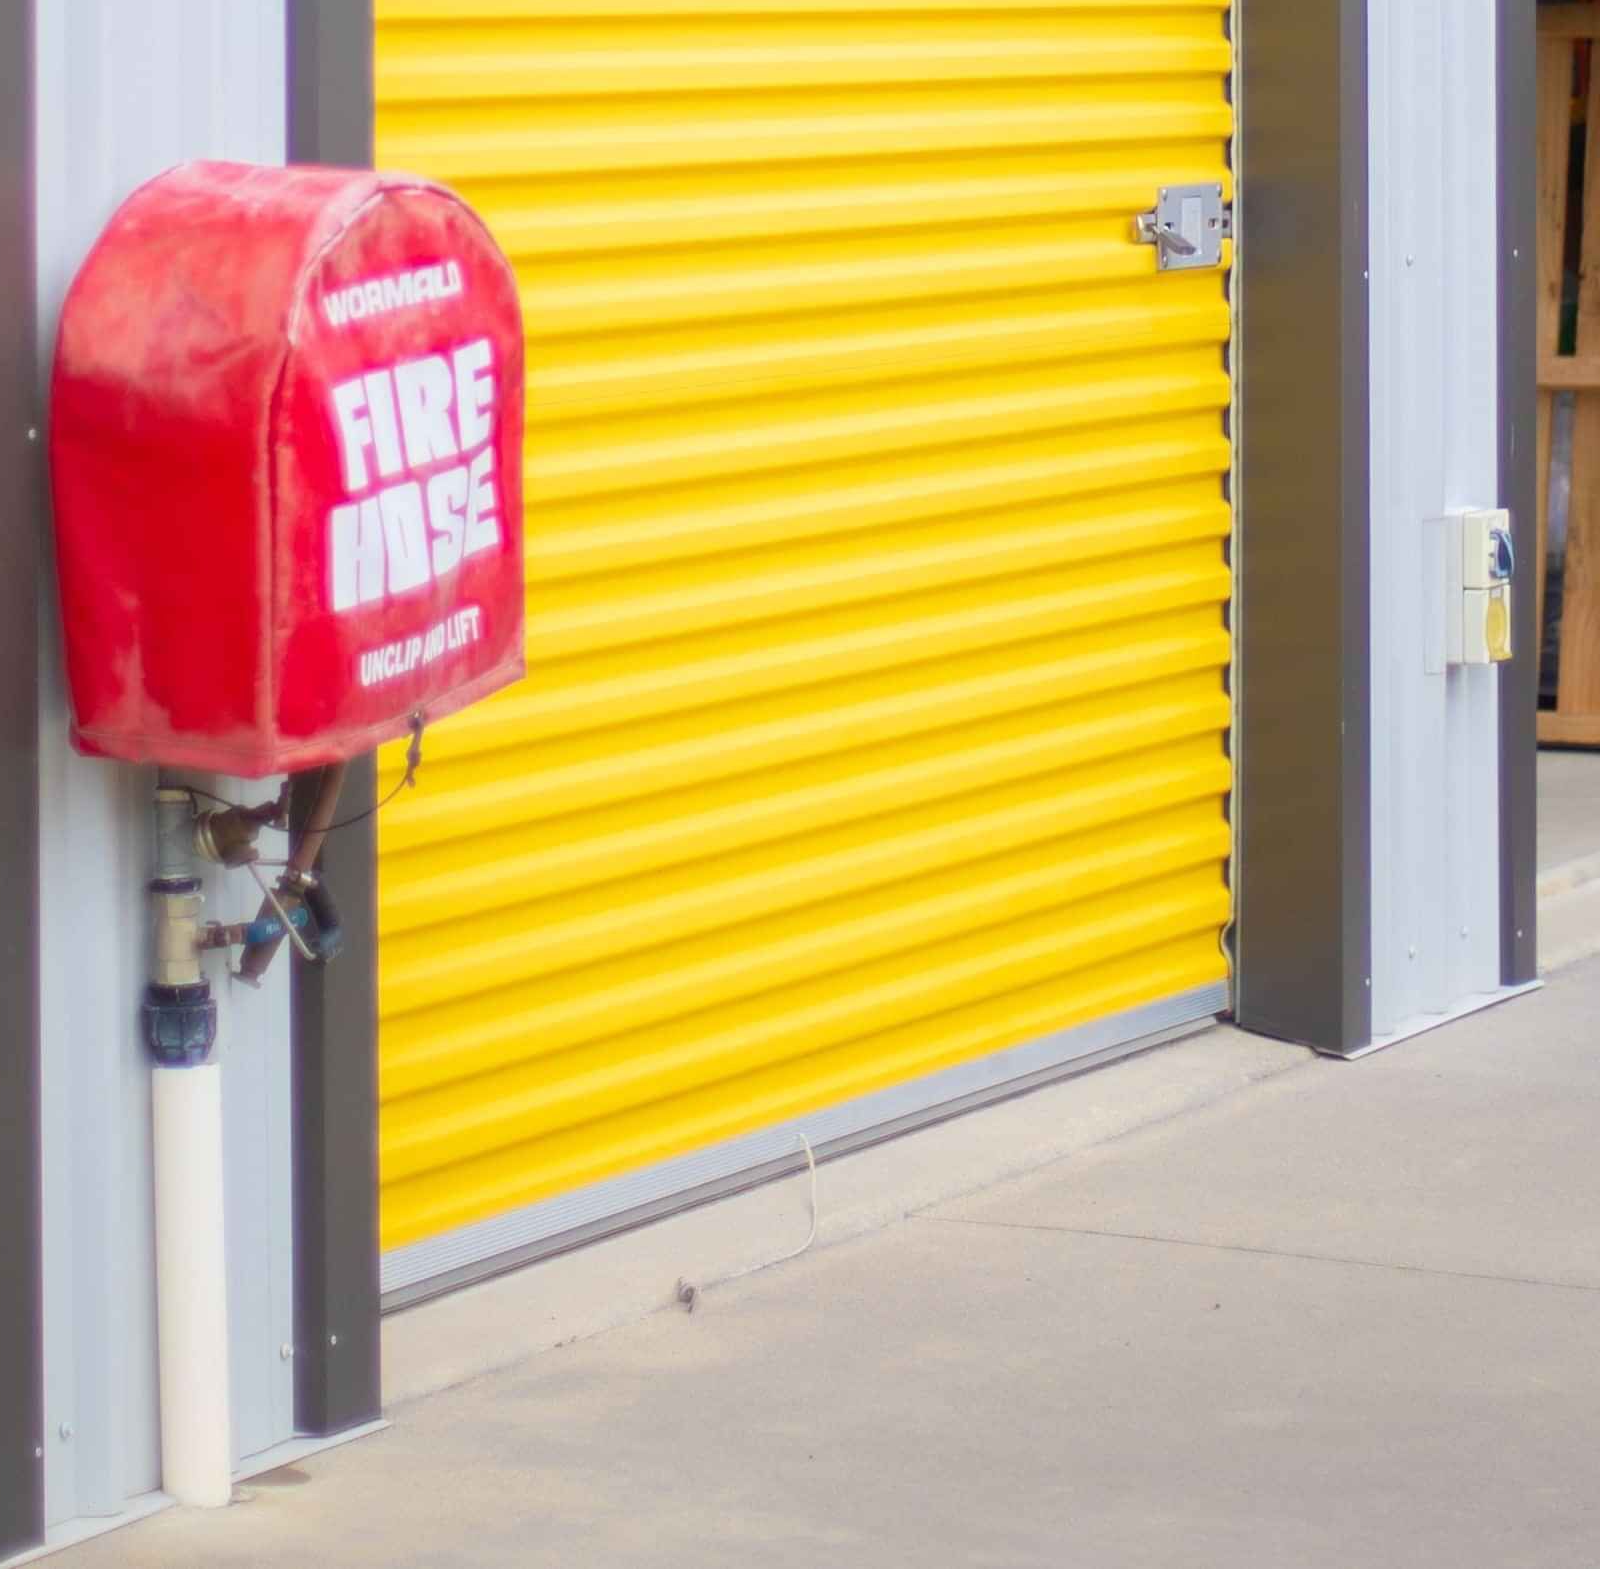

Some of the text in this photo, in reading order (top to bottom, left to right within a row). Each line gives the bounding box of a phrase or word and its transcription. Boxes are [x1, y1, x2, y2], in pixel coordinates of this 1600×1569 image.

[323, 260, 463, 327] WORMALD
[331, 338, 494, 493] FIRE
[331, 444, 502, 613] HOSE
[360, 634, 423, 688] UNCLIP
[447, 604, 482, 651] LIFT
